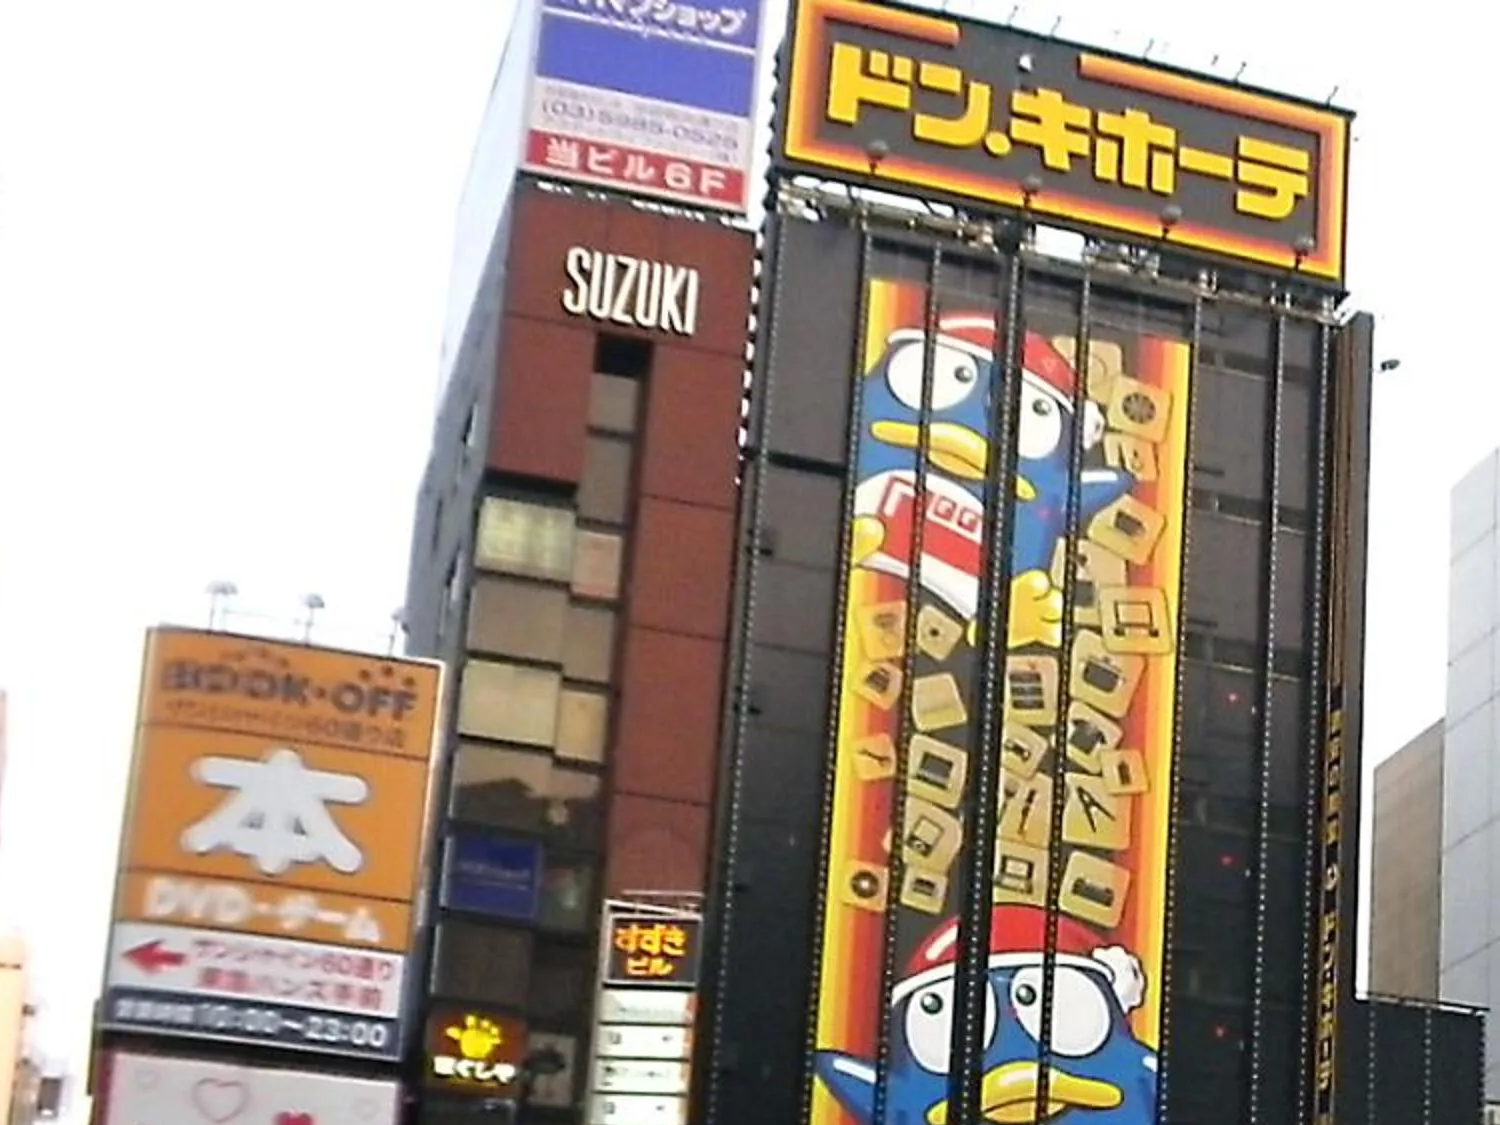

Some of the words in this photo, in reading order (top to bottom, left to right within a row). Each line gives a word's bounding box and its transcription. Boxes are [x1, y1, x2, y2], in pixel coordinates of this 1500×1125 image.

[546, 136, 727, 195] 当ビル6F
[563, 245, 699, 336] SUZUKI
[179, 747, 372, 878] 本
